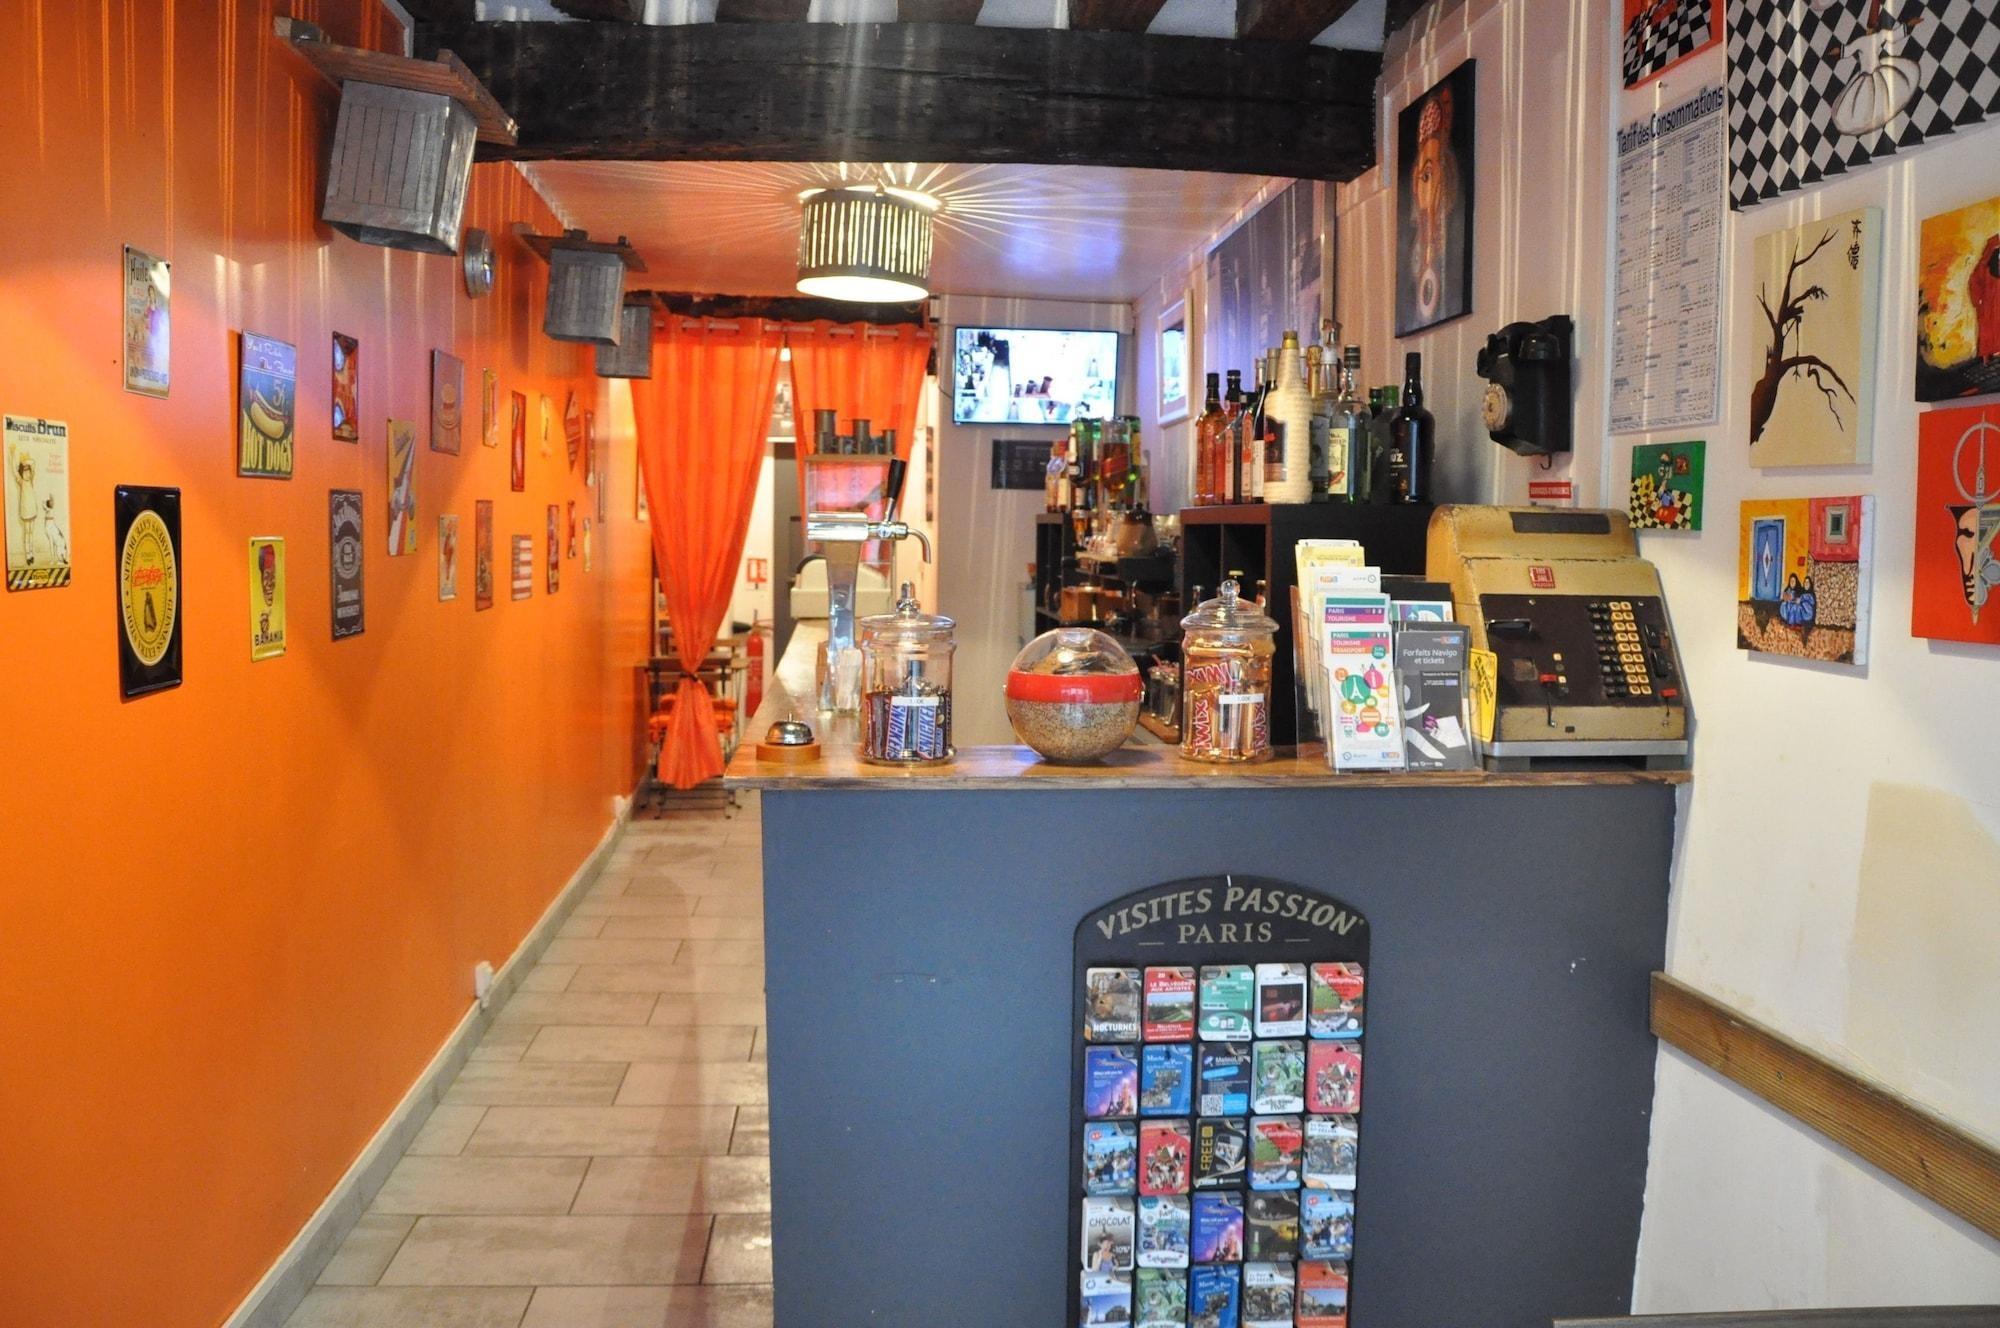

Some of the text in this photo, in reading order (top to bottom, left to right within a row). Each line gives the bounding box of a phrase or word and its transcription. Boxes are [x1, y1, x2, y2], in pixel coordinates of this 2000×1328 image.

[1617, 122, 1637, 155] Tarif
[1651, 86, 1724, 138] Consommations
[37, 418, 66, 438] Brun
[242, 409, 293, 474] HOT DOGS
[1403, 649, 1457, 658] Forfaits Navigo
[1423, 657, 1445, 665] tickets
[1097, 886, 1357, 939] VISITES PASSION
[1177, 922, 1272, 944] PARIS
[1093, 1022, 1137, 1033] NOCTURNES
[1089, 1216, 1131, 1227] CHOCOLAT
